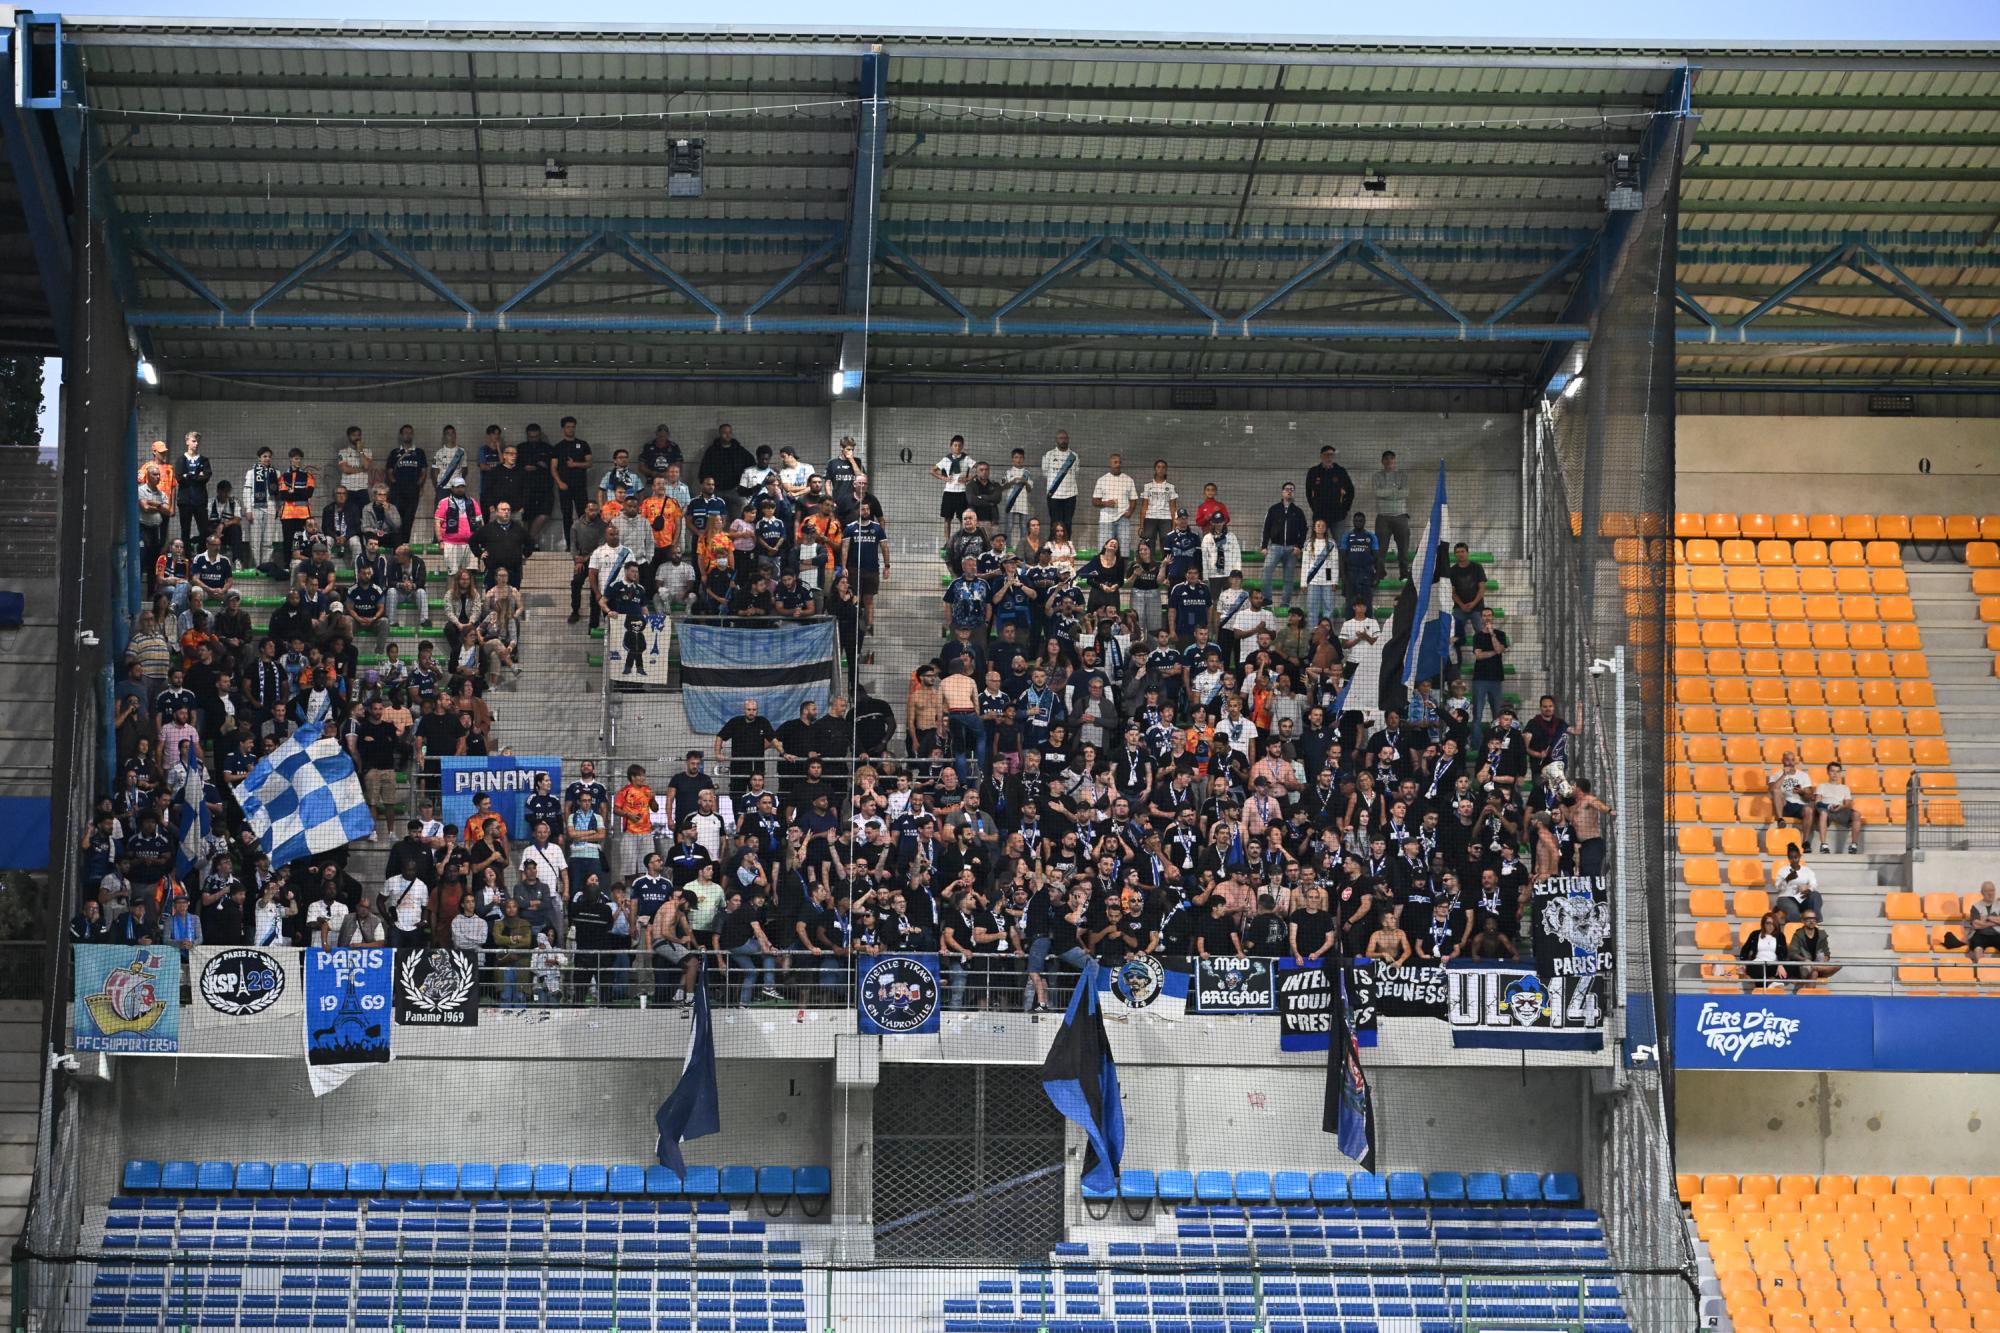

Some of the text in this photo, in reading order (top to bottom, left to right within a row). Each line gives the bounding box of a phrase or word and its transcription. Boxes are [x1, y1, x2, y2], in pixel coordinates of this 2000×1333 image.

[455, 770, 549, 793] PANAM
[1534, 876, 1591, 895] SECTION
[223, 951, 246, 960] PARIS
[317, 949, 383, 970] PARIS
[1214, 957, 1250, 971] MAD
[1553, 952, 1613, 976] PARIS FC
[207, 969, 275, 994] KSP 26
[336, 968, 365, 987] FC
[867, 961, 931, 984] VIEILLE FIRME
[1377, 961, 1443, 984] ROULEZ
[320, 995, 385, 1011] 19 69
[1201, 990, 1269, 1007] BRIGADE
[1375, 981, 1448, 1004] JEUNESS
[1448, 973, 1601, 1028] UL 14
[405, 1010, 464, 1022] Paname 1969
[881, 1004, 931, 1028] VADROUILLE
[1697, 1002, 1741, 1032] FIERS
[1702, 1026, 1792, 1062] TROYENS.
